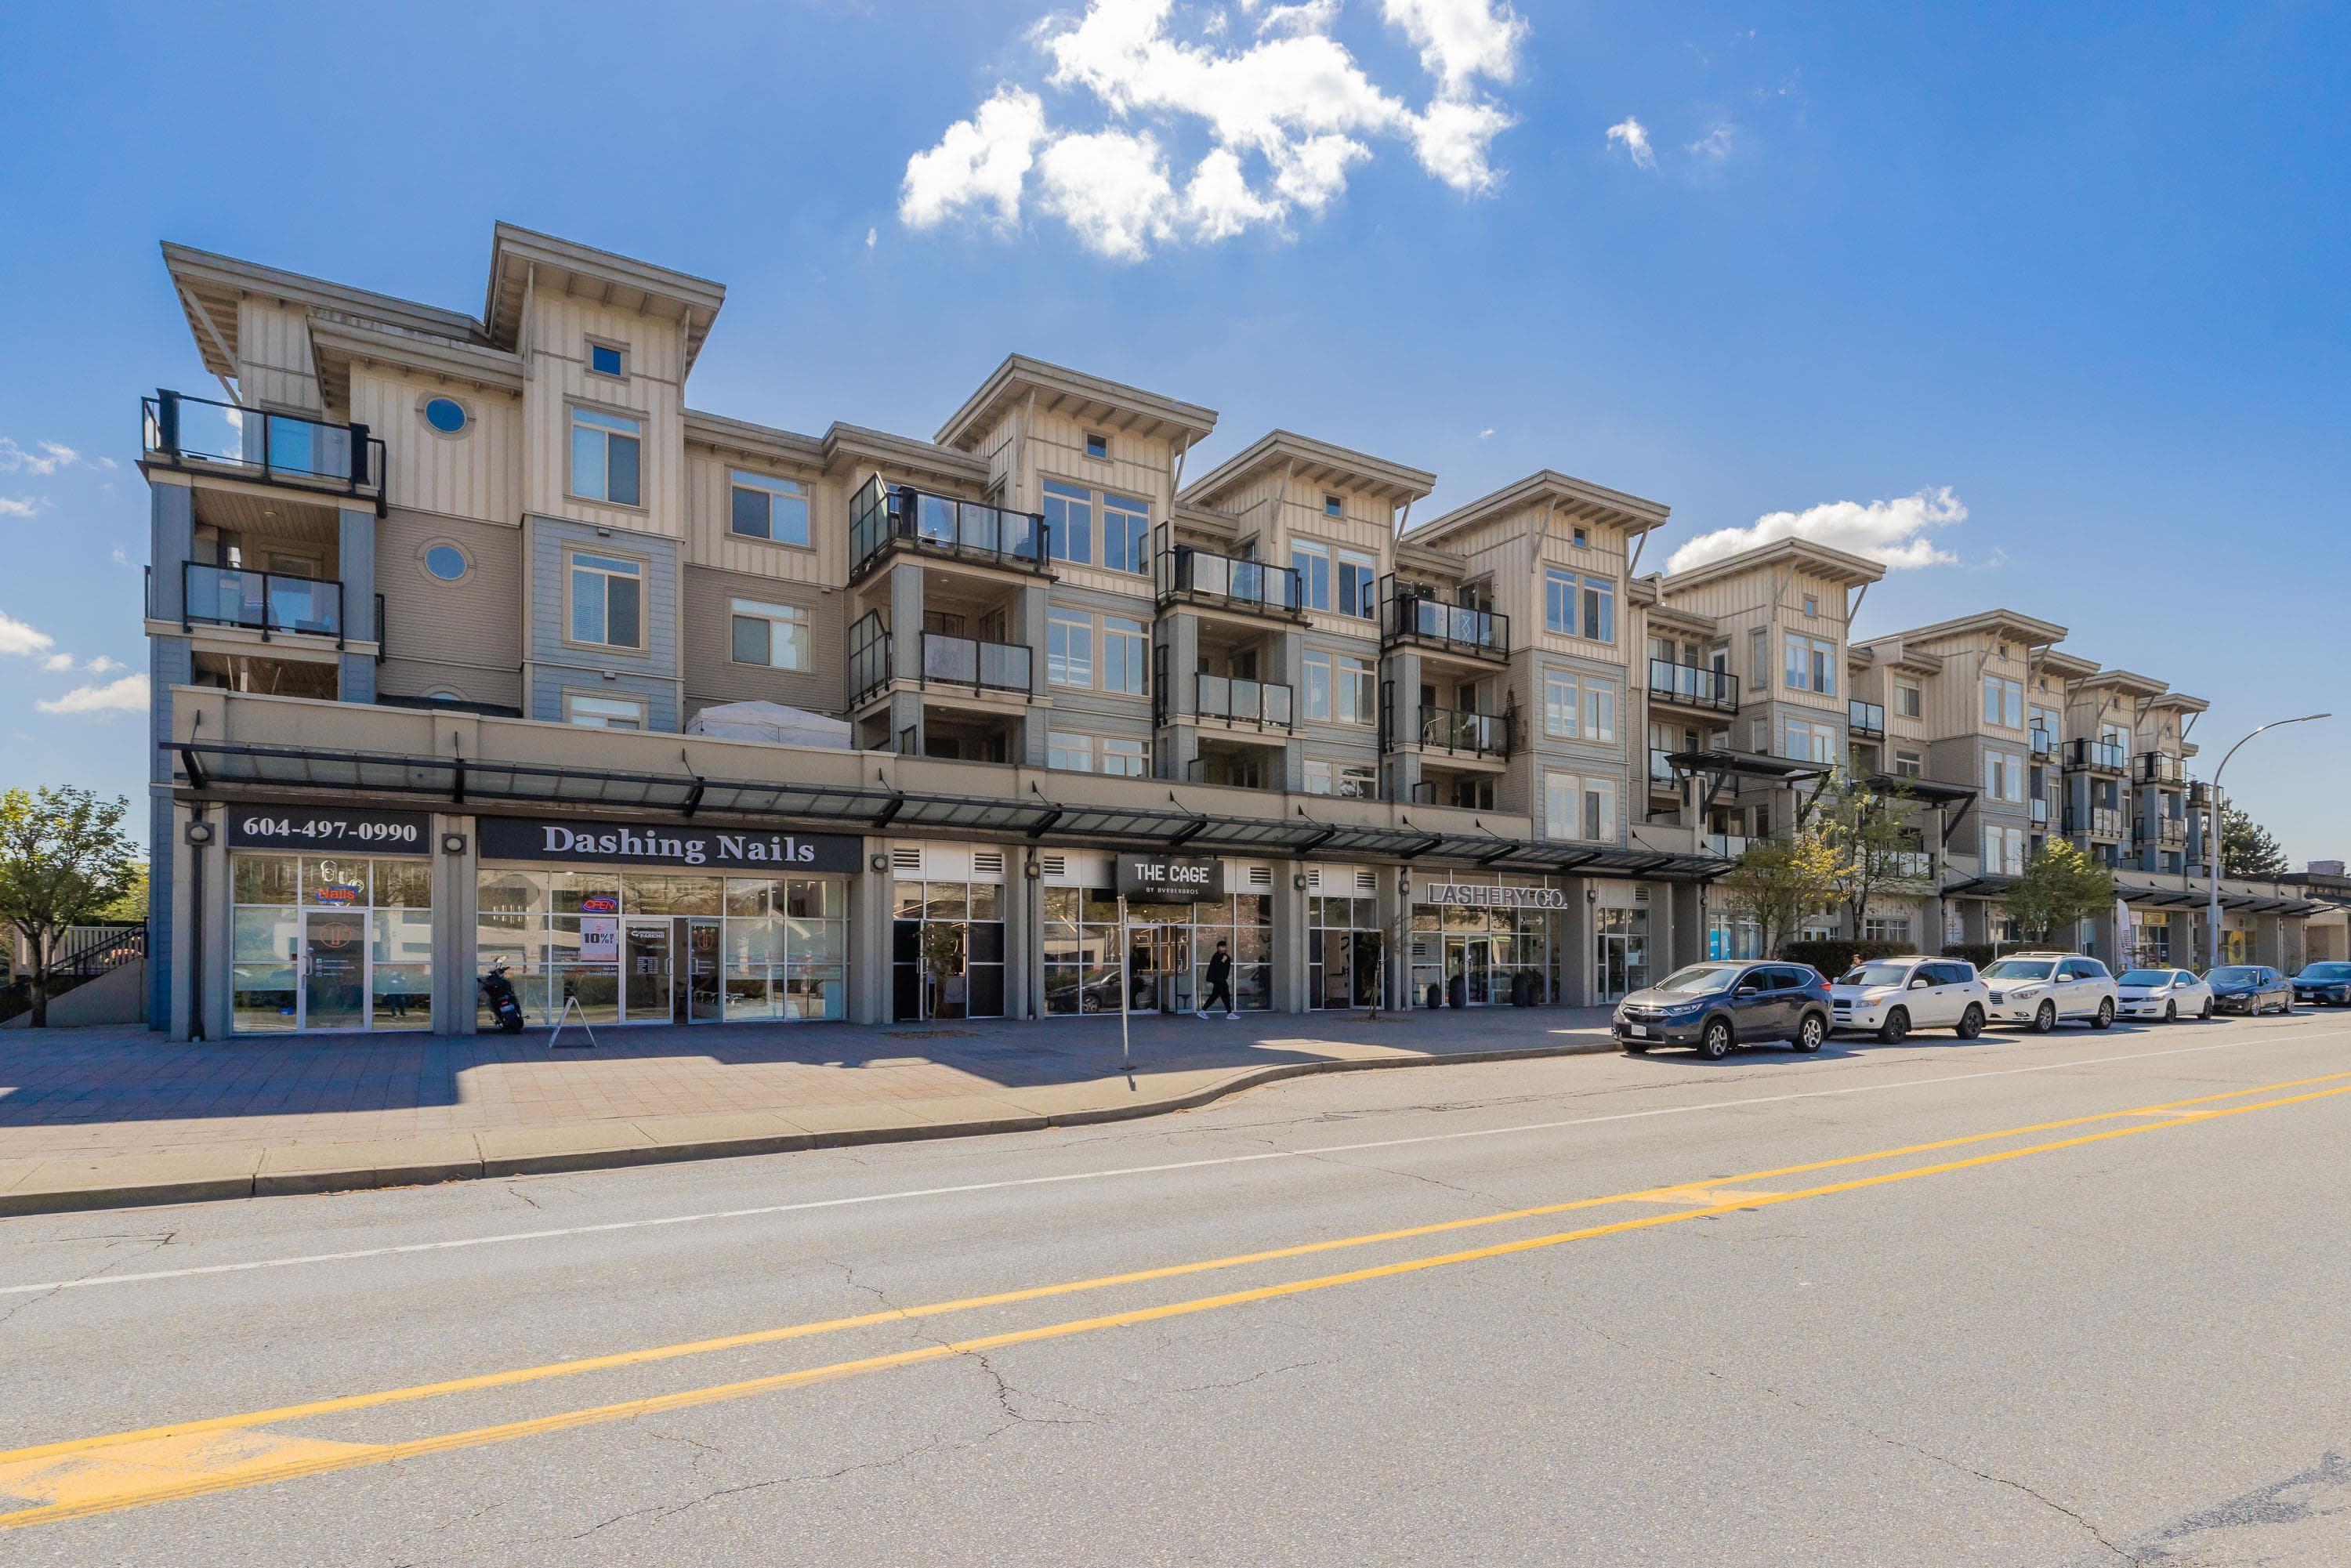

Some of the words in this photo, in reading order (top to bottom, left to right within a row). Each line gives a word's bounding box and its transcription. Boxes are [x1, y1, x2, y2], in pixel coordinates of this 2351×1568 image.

[243, 817, 417, 842] 604-497-0990
[542, 826, 706, 864] Dashing
[716, 835, 815, 862] Nails
[1134, 863, 1165, 882] THE
[1169, 865, 1209, 883] CAGE
[318, 887, 355, 900] Nails
[1429, 884, 1529, 907] LASHERY
[1534, 889, 1568, 910] CO.
[585, 900, 615, 910] OPEN
